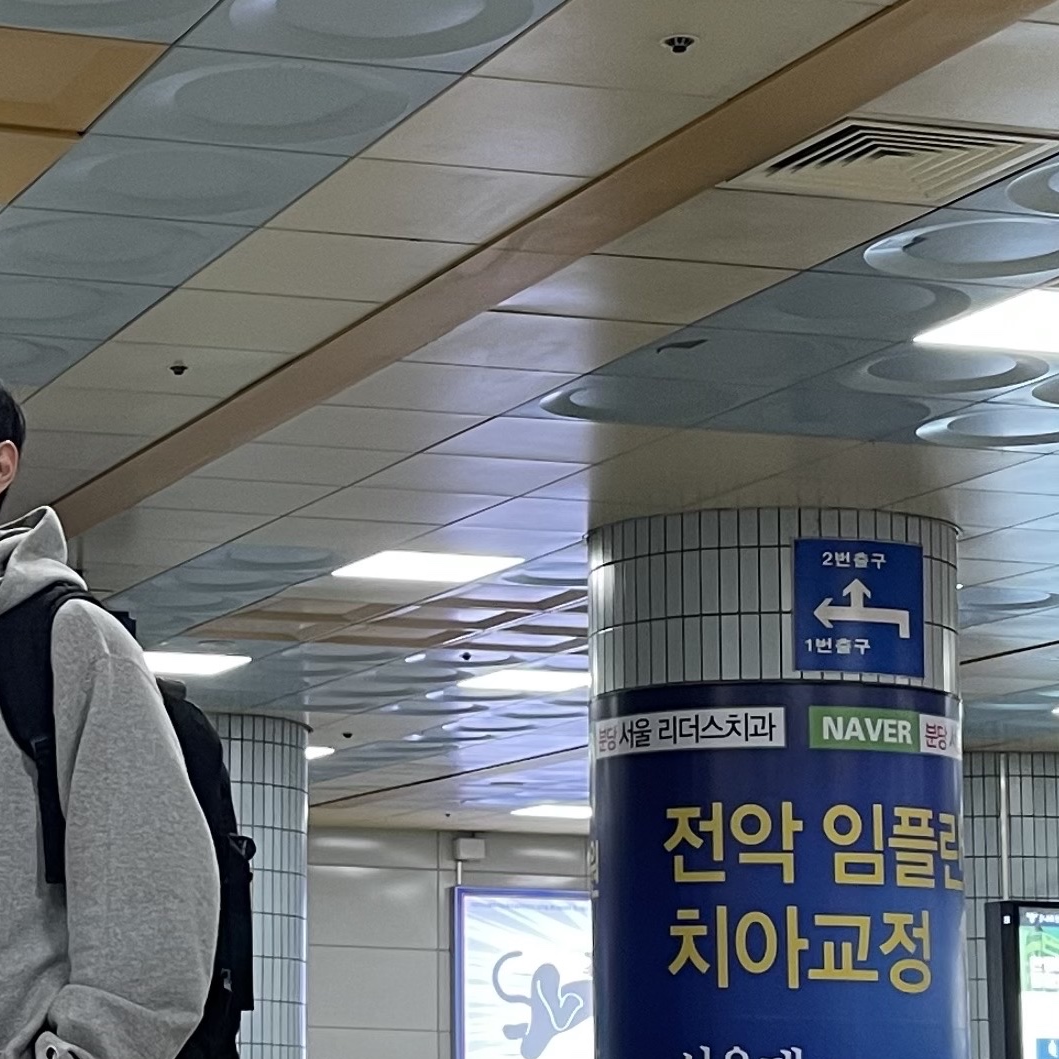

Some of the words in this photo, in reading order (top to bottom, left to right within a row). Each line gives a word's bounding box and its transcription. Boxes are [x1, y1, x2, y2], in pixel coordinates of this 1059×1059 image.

[822, 551, 887, 570] 2번출구
[804, 637, 871, 655] 1번출구
[658, 712, 777, 745] 리더스치과
[822, 715, 913, 745] NAVER
[663, 801, 804, 884] 전악
[667, 905, 932, 993] 치아교정
